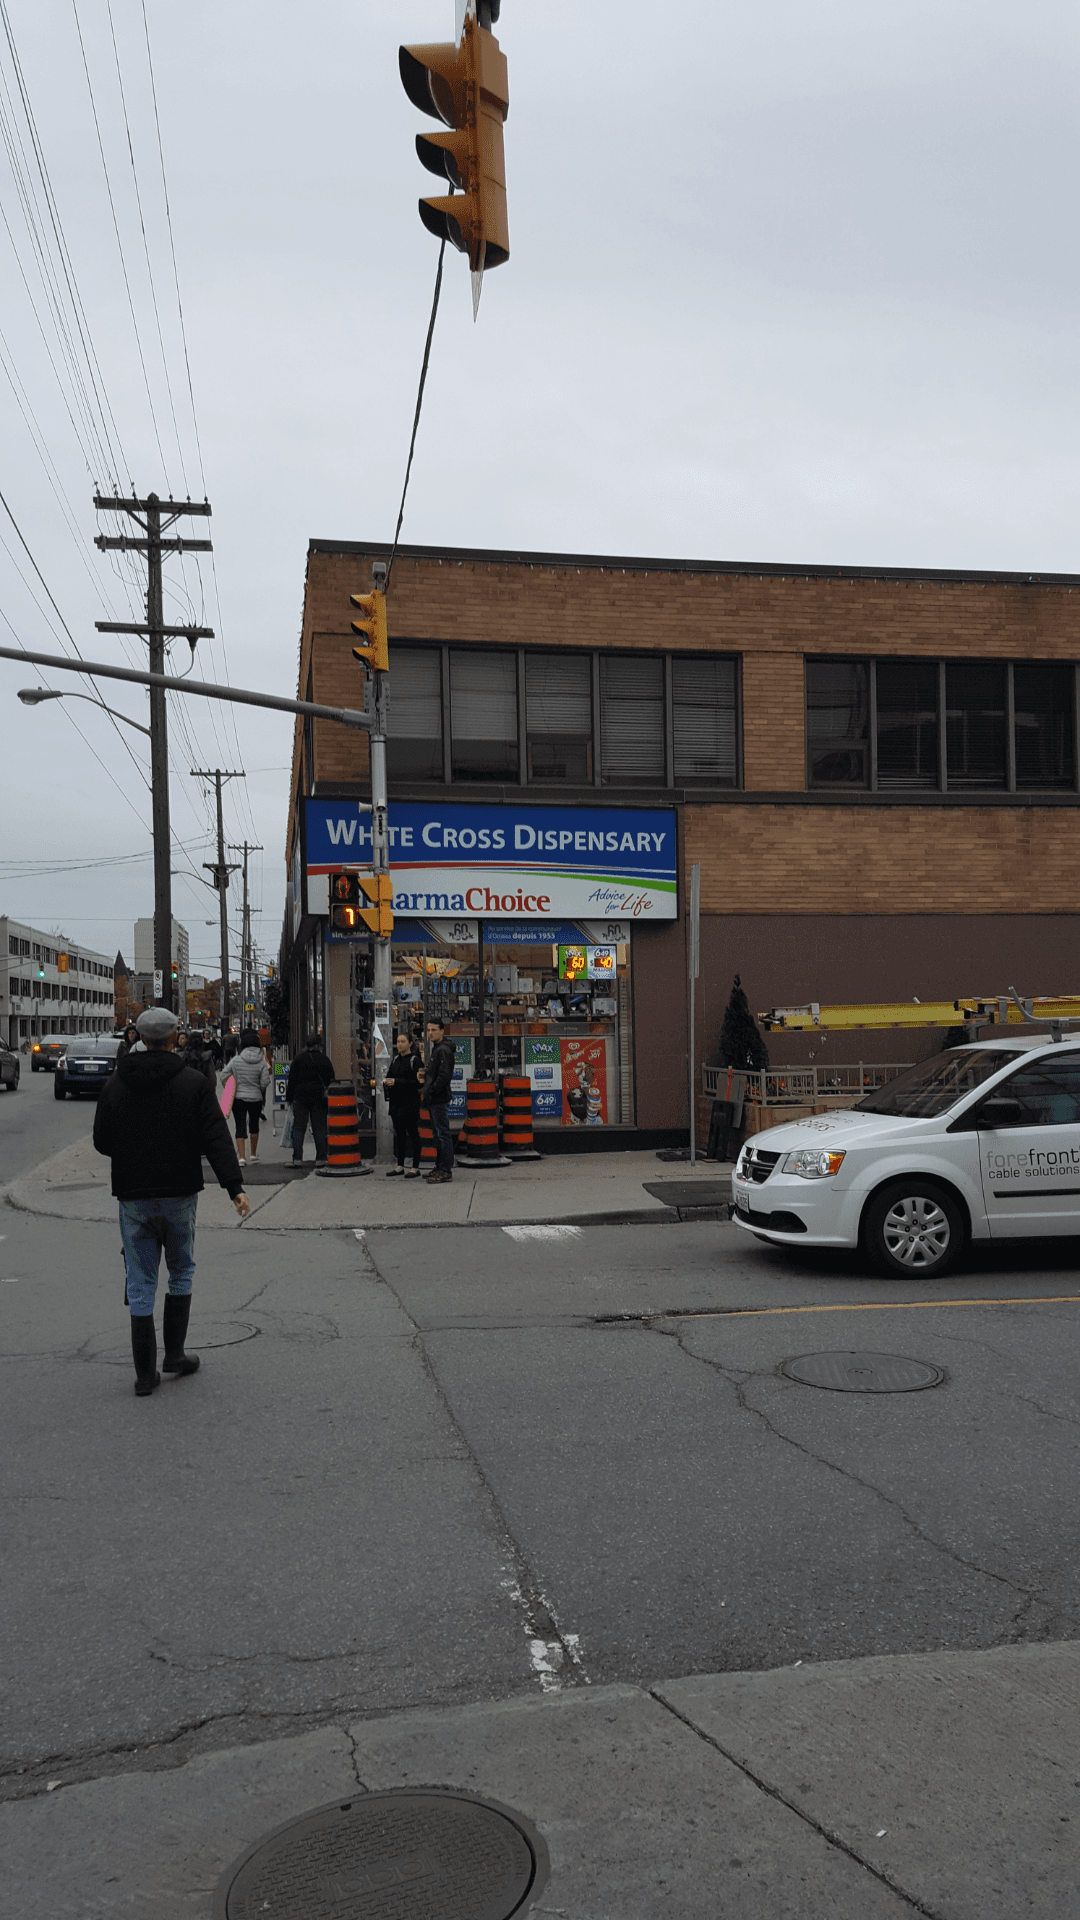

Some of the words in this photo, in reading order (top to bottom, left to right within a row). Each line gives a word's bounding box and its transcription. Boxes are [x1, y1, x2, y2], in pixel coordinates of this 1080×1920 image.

[326, 818, 414, 847] WHTE
[422, 822, 506, 849] CROSS
[515, 824, 666, 852] DISPENSARY
[359, 887, 551, 912] armaChoice
[588, 888, 626, 902] Advice
[605, 901, 619, 914] for
[621, 892, 654, 917] Life
[531, 1043, 553, 1054] MAX
[536, 1096, 555, 1105] 649
[985, 1148, 1080, 1169] forefront
[988, 1167, 1021, 1179] cable
[1024, 1165, 1080, 1178] solutions
